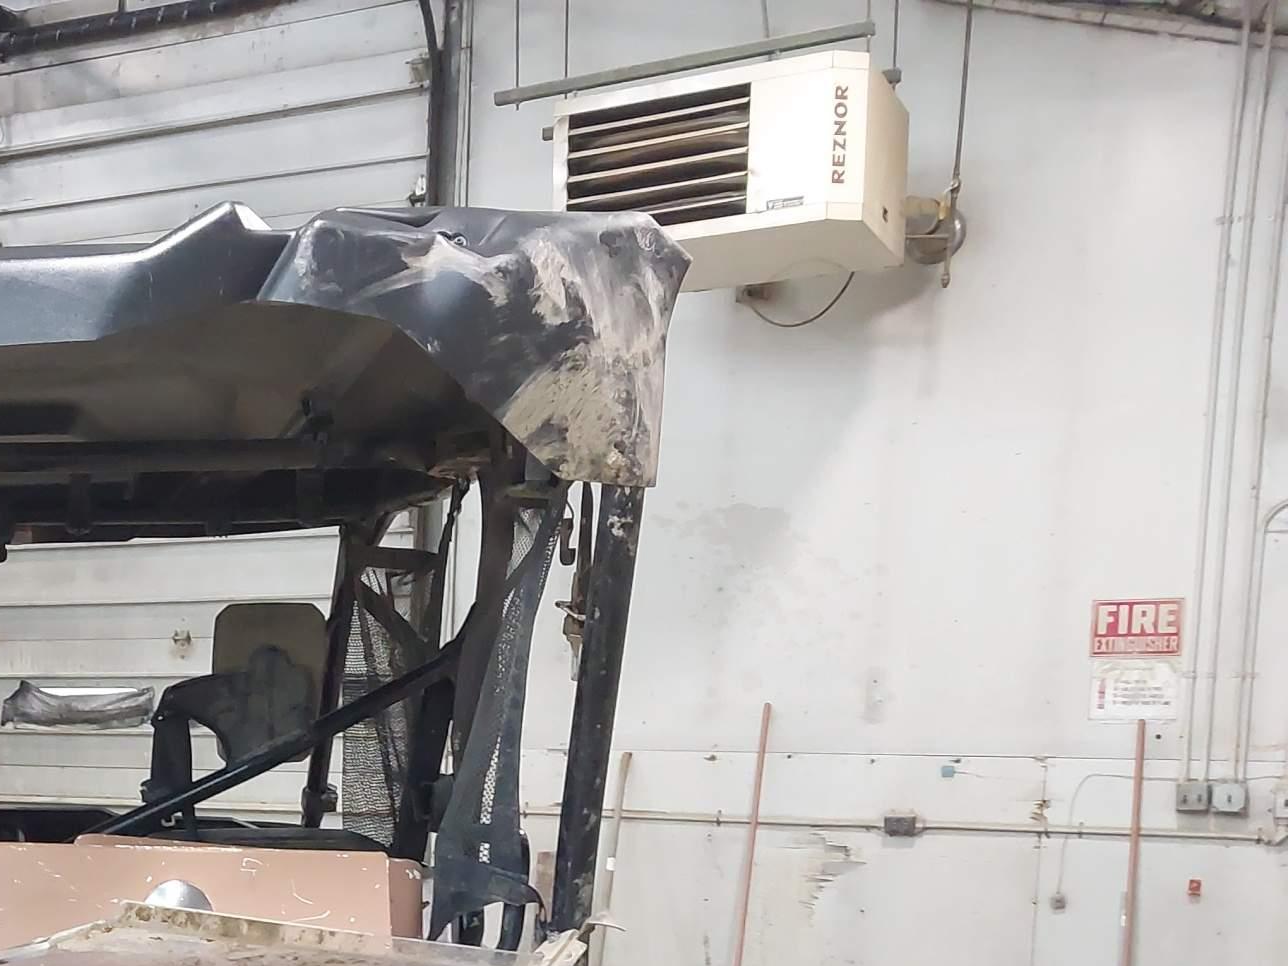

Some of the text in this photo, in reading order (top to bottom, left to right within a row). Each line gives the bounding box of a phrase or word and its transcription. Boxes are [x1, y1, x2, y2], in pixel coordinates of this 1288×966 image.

[831, 85, 849, 184] REZNOR
[1097, 603, 1179, 635] FIRE
[1094, 636, 1179, 653] EXTINGUISHER
